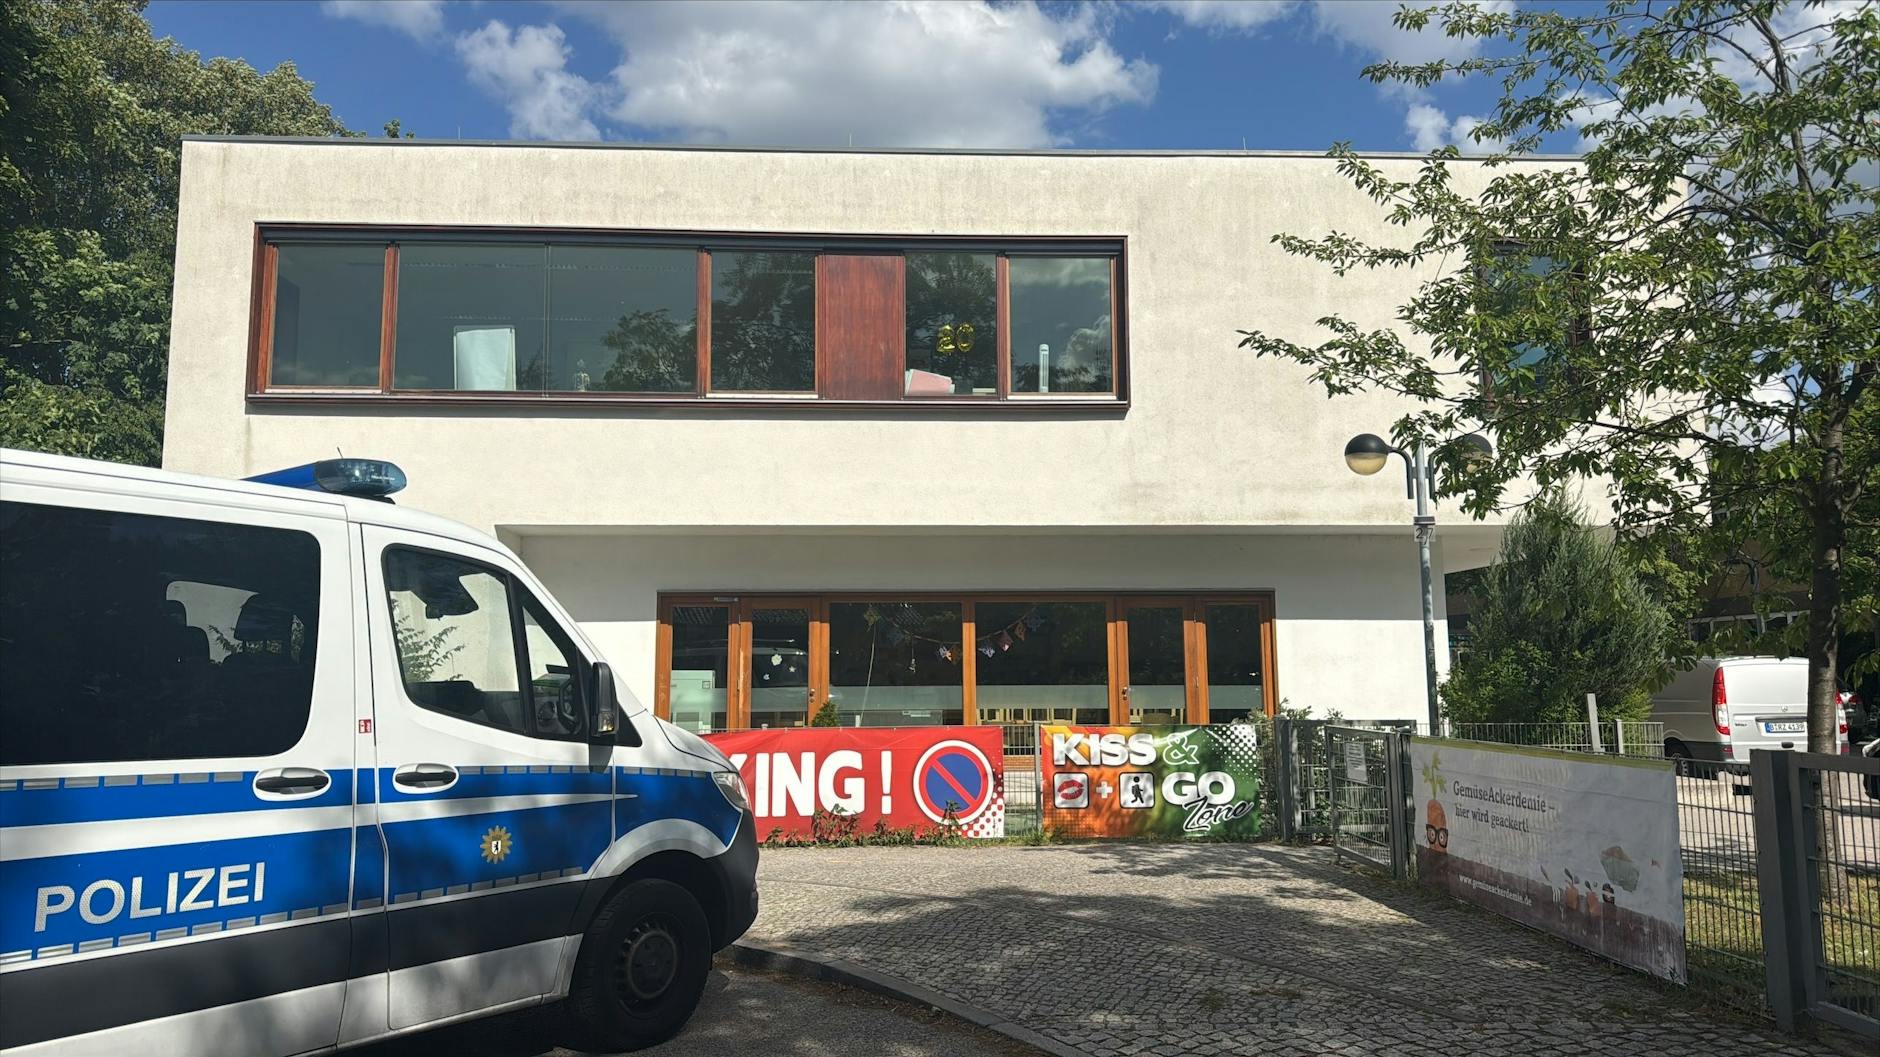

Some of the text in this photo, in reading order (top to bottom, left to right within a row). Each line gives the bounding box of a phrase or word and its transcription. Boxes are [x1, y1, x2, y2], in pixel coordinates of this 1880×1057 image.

[937, 324, 976, 352] 20
[1052, 733, 1200, 766] KISS &
[728, 750, 866, 817] ING
[1161, 771, 1236, 805] GO
[1453, 780, 1547, 813] GemüseAckerdemie
[1183, 796, 1255, 832] Zone
[1455, 803, 1530, 833] hier wird geackert!
[34, 861, 266, 933] POLIZEI
